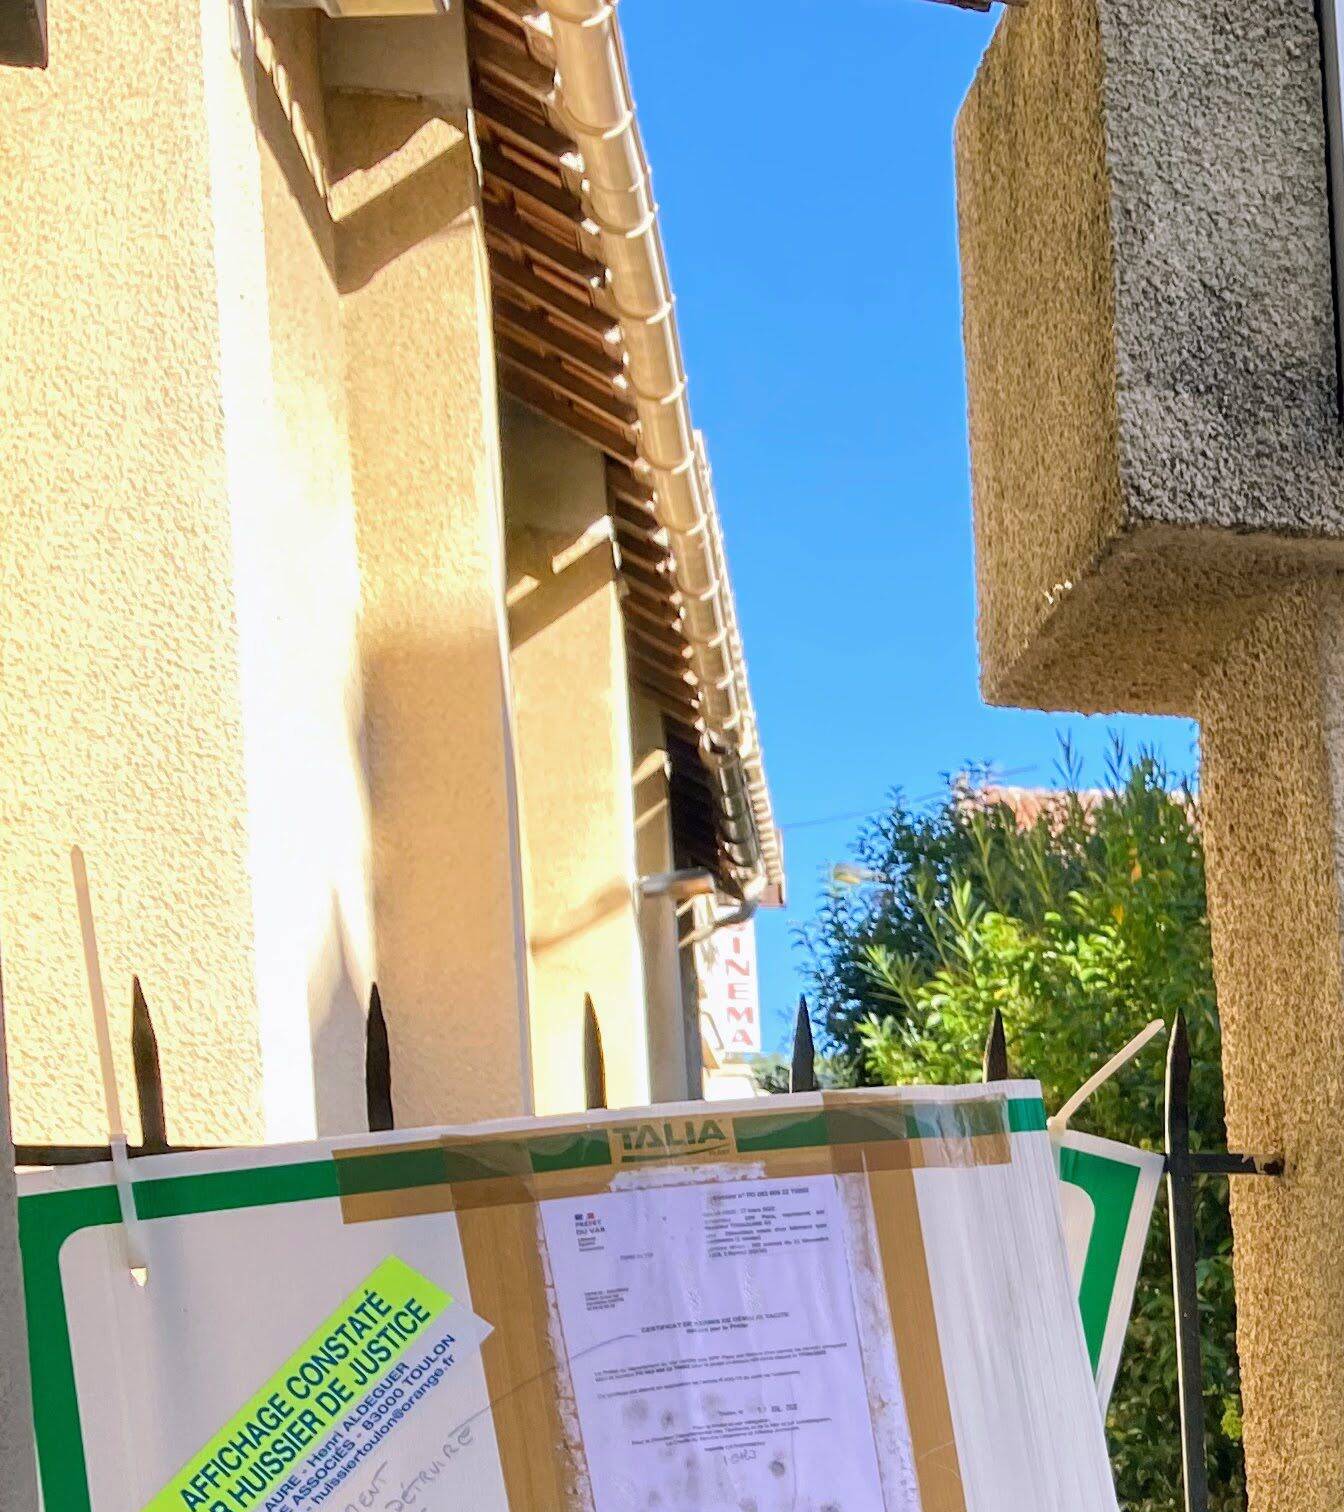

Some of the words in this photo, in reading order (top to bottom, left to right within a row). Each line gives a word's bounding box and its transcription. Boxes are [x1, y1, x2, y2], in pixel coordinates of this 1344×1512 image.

[725, 926, 754, 1046] INEMA
[181, 1393, 293, 1512] AFFICHAGE
[286, 1290, 391, 1399] CONSTATÉ
[227, 1409, 324, 1507] HUISSIER
[314, 1377, 354, 1416] DE
[349, 1298, 430, 1385] JUSTICE
[286, 1439, 355, 1505] ASSOCIÉS
[361, 1387, 404, 1430] 83000
[401, 1334, 455, 1385] TOULON
[304, 1355, 453, 1503] huissiertoulon@orange.fr
[306, 1430, 343, 1467] Henri
[342, 1362, 409, 1431] ALDEGUER
